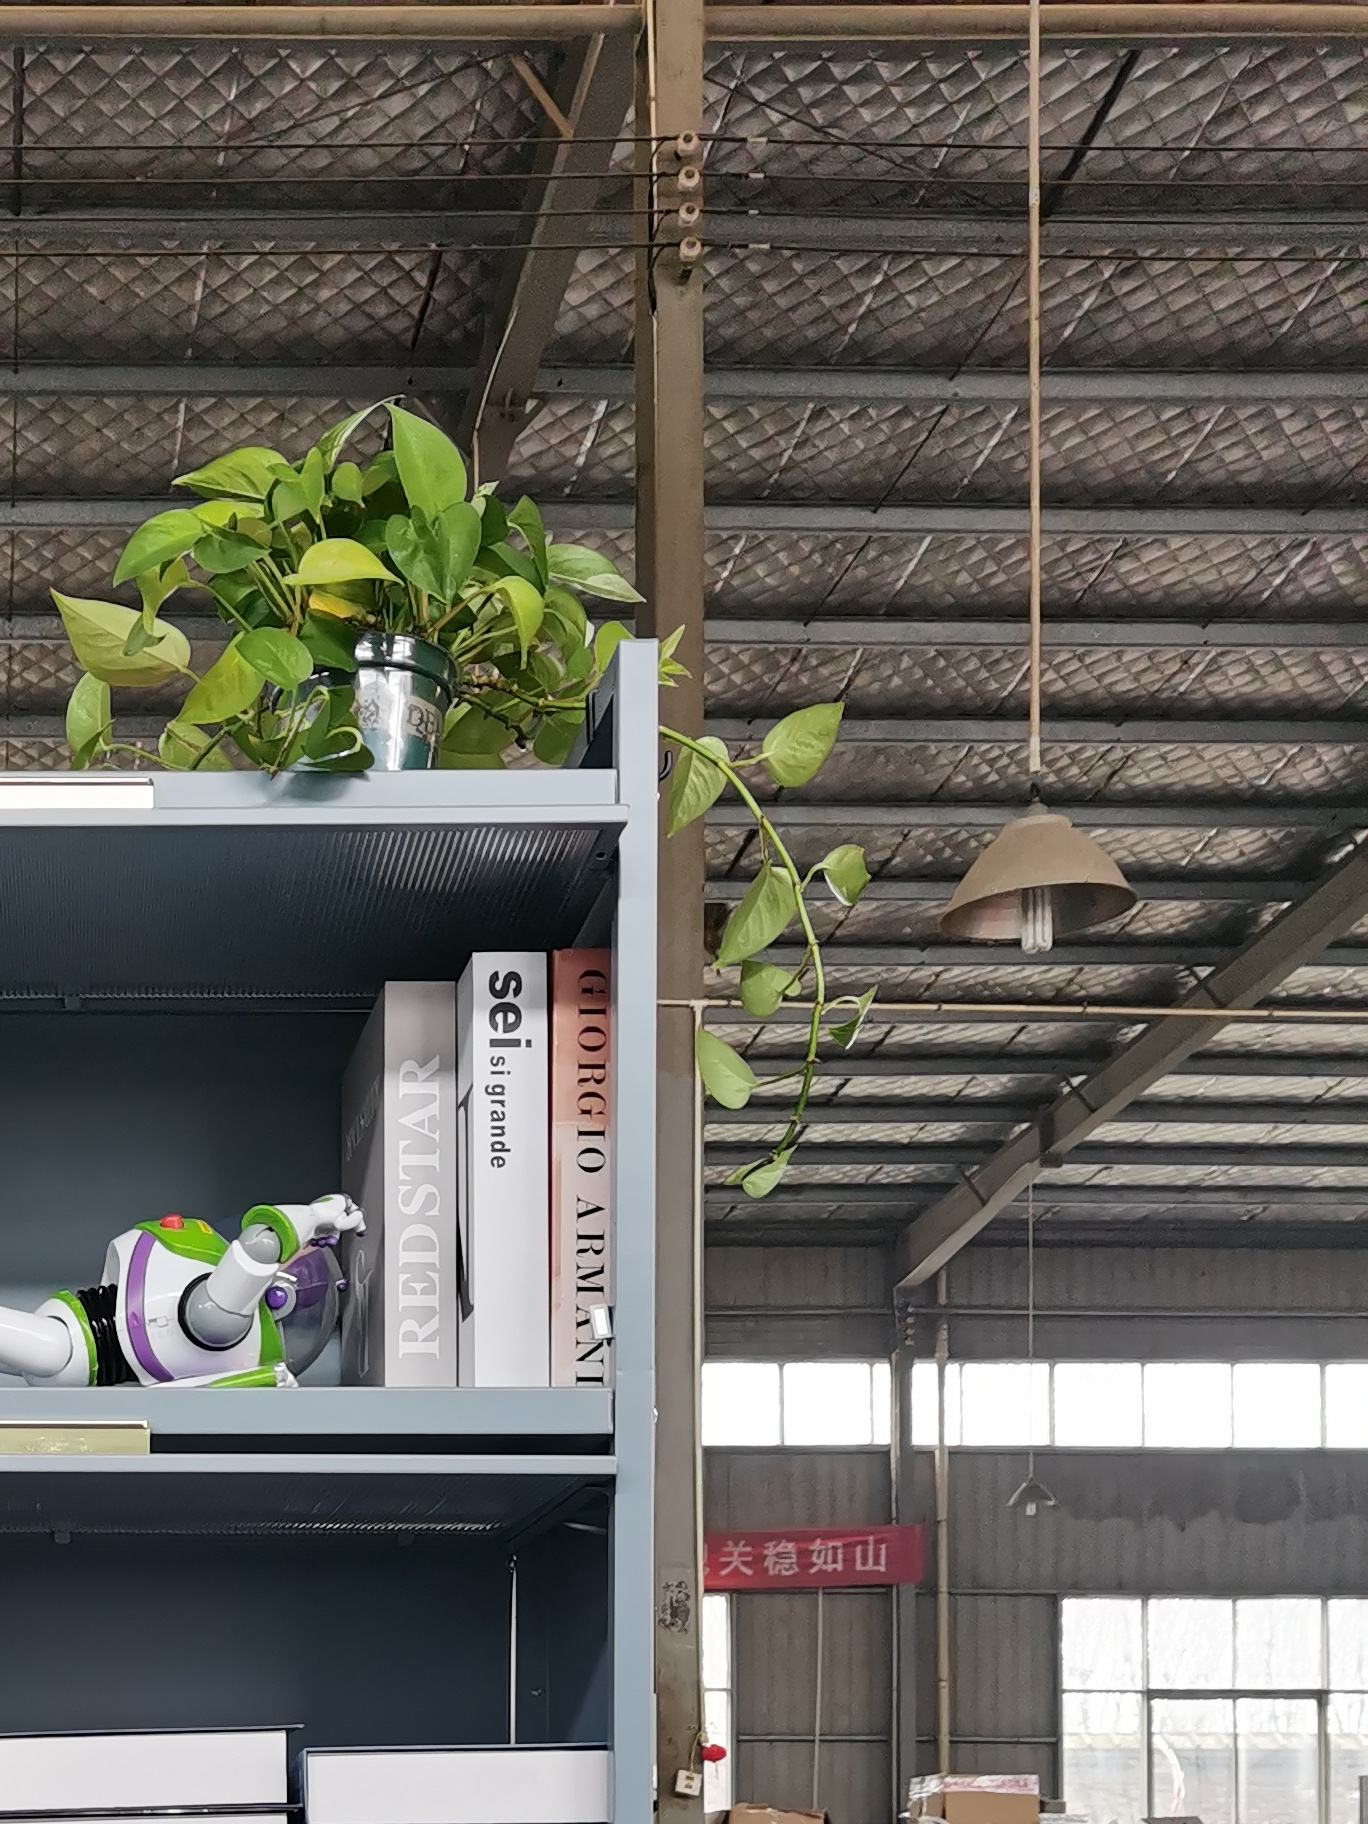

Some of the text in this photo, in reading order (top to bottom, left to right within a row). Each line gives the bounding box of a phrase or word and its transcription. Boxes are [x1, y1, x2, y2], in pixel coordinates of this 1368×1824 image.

[484, 970, 533, 1169] sei si grande
[576, 969, 608, 1174] GIORGIO
[704, 1536, 887, 1577] 关稳如山
